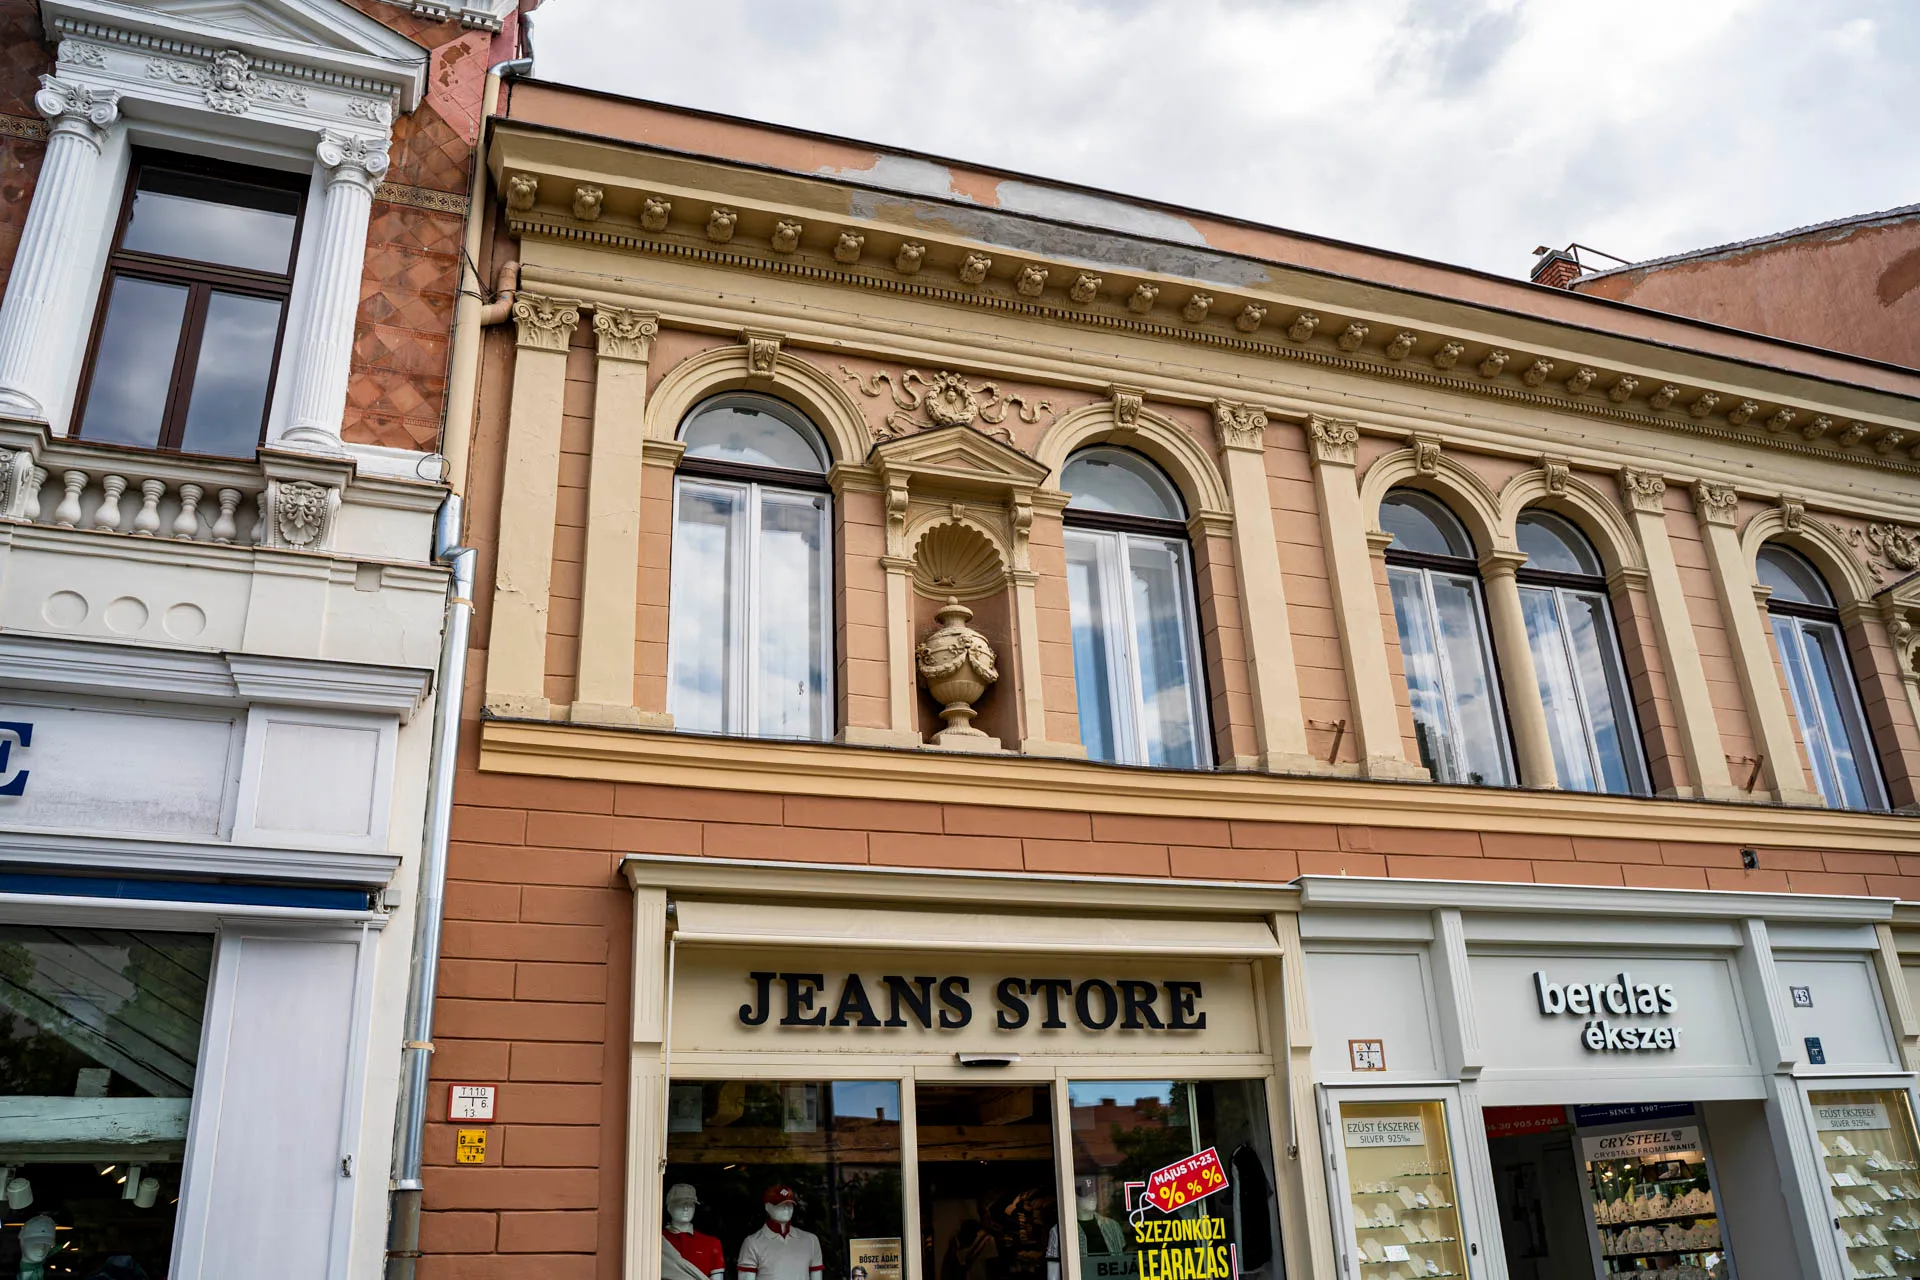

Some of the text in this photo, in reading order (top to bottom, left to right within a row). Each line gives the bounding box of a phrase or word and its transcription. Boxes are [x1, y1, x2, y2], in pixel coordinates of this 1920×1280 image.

[738, 971, 1207, 1031] JEANS STORE
[1796, 990, 1809, 1002] 43
[1581, 1020, 1683, 1051] ékszer
[1609, 1107, 1636, 1117] SINCE
[1347, 1120, 1420, 1133] EZÜST ÉKSZEREK
[1360, 1135, 1385, 1144] SILVER
[1599, 1131, 1672, 1150] CRYSTEEL
[1594, 1149, 1636, 1160] CRYSTALS
[1637, 1146, 1662, 1156] FROM
[1154, 1164, 1188, 1185] MÁJUS
[1136, 1215, 1226, 1243] SZEZONKÖZI
[1138, 1241, 1230, 1280] LEÁRAZÁS
